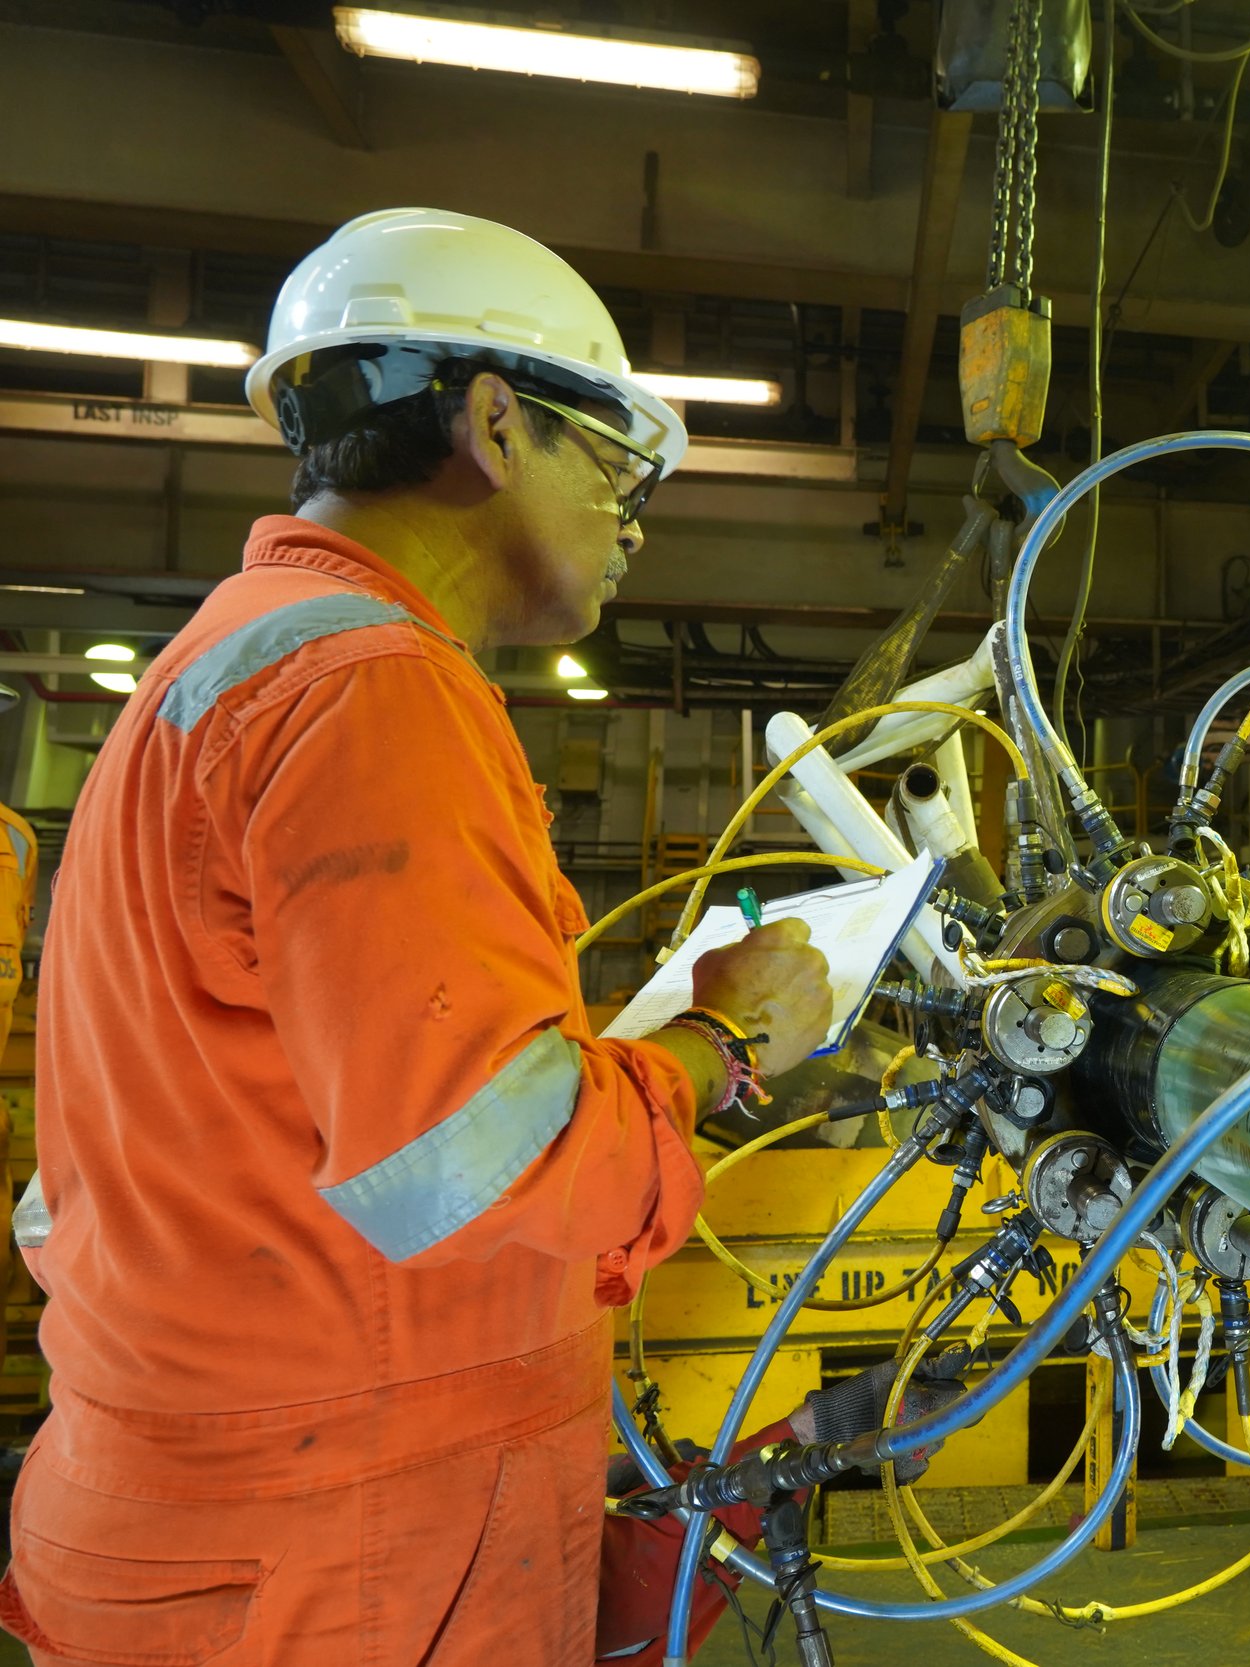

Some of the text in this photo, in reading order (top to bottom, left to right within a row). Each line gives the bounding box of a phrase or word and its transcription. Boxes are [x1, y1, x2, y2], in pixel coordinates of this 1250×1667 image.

[73, 402, 179, 427] LAST INSP
[842, 1270, 885, 1301] UP
[903, 1267, 1013, 1302] TAE
